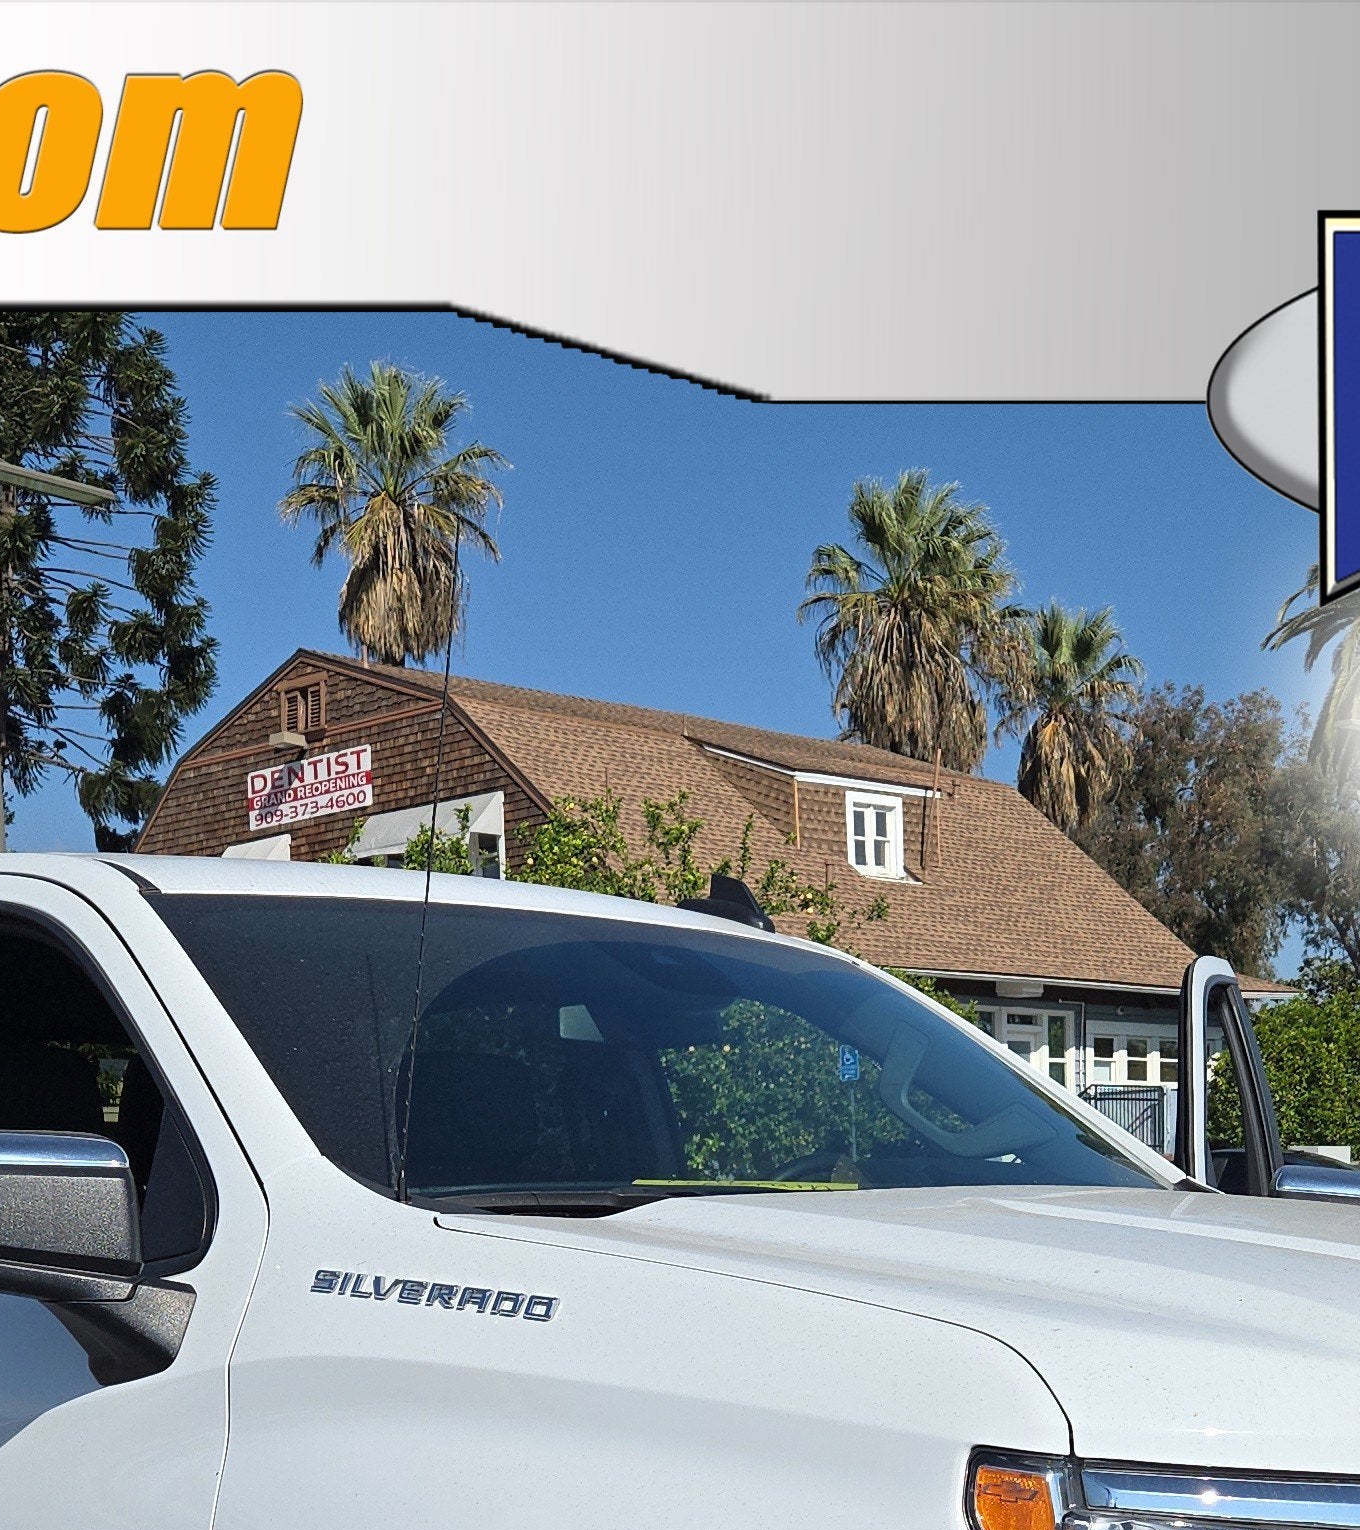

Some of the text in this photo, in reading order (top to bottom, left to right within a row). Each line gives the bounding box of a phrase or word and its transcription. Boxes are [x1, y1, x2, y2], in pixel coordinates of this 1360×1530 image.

[250, 748, 368, 796] DENTIST
[253, 772, 367, 809] GRAND REOPENING
[254, 790, 367, 827] 909-373-4600
[310, 1269, 560, 1322] SILVERADO
